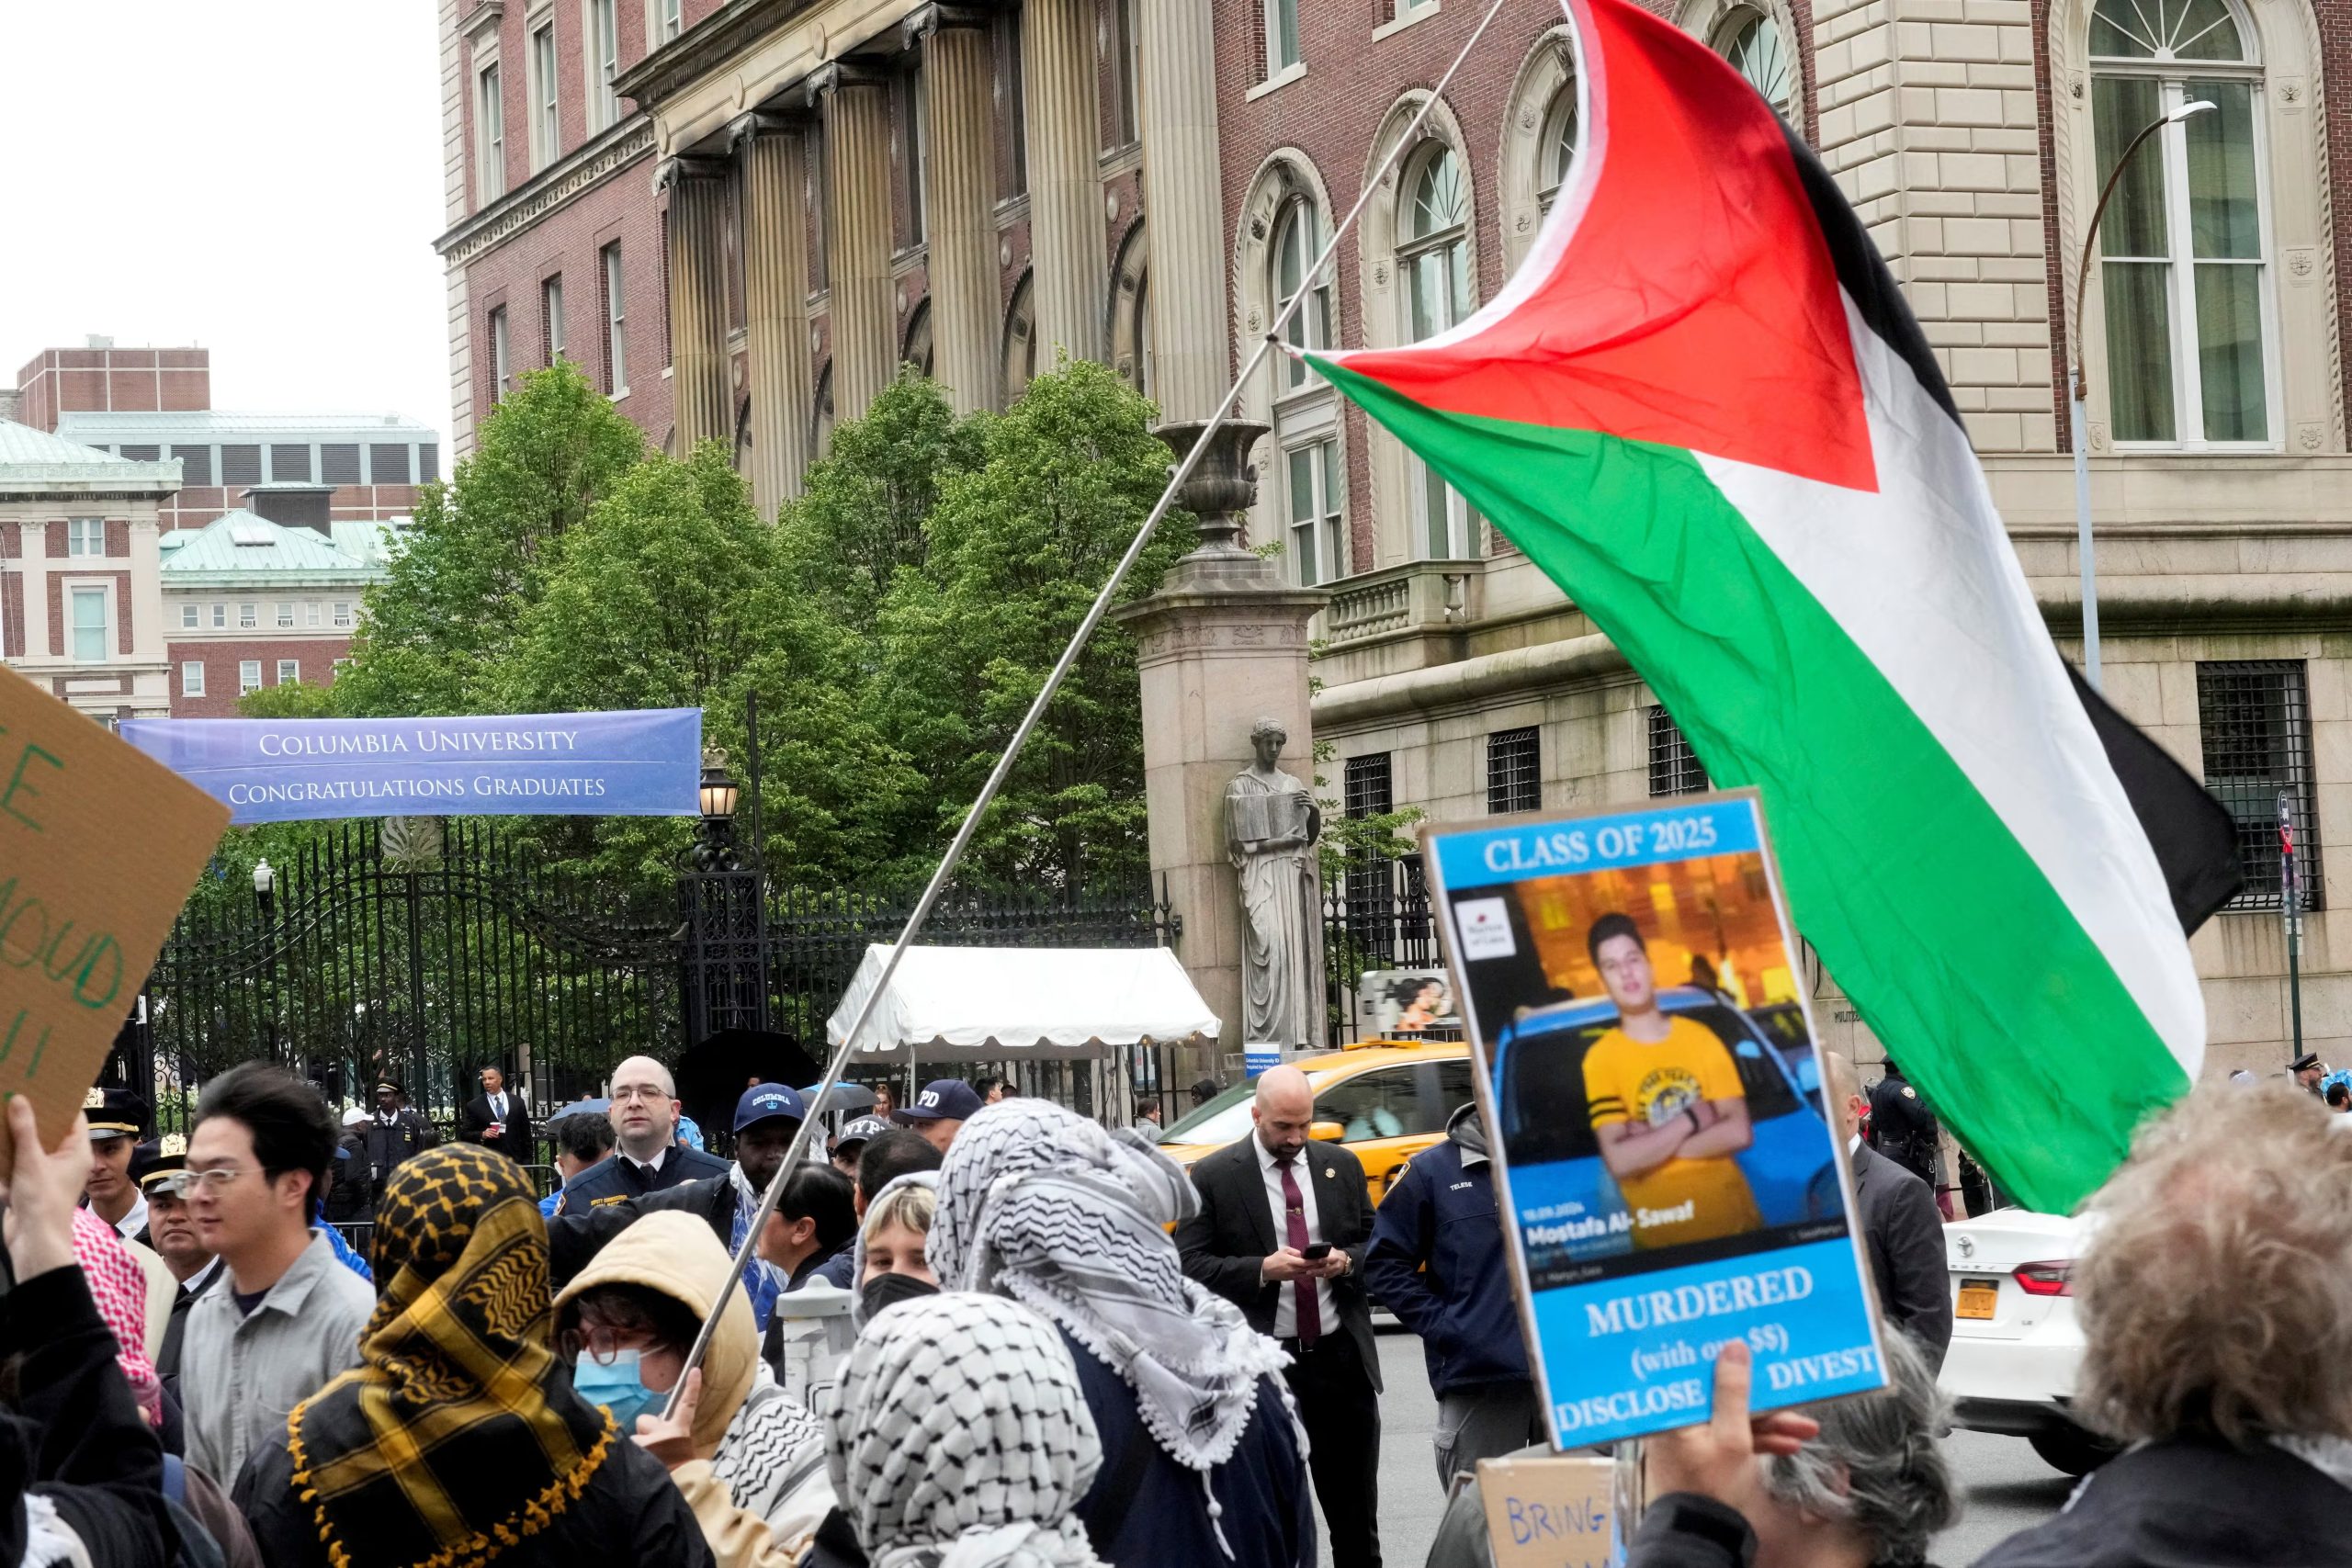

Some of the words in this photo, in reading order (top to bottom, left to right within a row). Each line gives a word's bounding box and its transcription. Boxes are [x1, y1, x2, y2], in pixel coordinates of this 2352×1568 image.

[259, 734, 409, 756] COLUMBIA
[417, 730, 578, 751] UNIVERSITY
[0, 724, 65, 833] E
[229, 778, 464, 805] CONGRATULATIONS
[474, 775, 605, 795] GRADUATES
[1484, 830, 1589, 873] CLASS
[1597, 824, 1643, 859] OF
[1649, 816, 1717, 852] 2025
[0, 877, 124, 1010] OUD
[752, 1093, 790, 1106] COLUMBIA
[842, 1120, 886, 1138] NYP
[1527, 1215, 1607, 1247] Mostafa
[1636, 1199, 1695, 1229] Sawaf
[1584, 1265, 1814, 1337] MURDERED
[1630, 1338, 1696, 1382] (with
[1555, 1377, 1706, 1432] DISCLOSE
[1767, 1345, 1878, 1391] DIVEST
[1505, 1495, 1606, 1546] BRING
